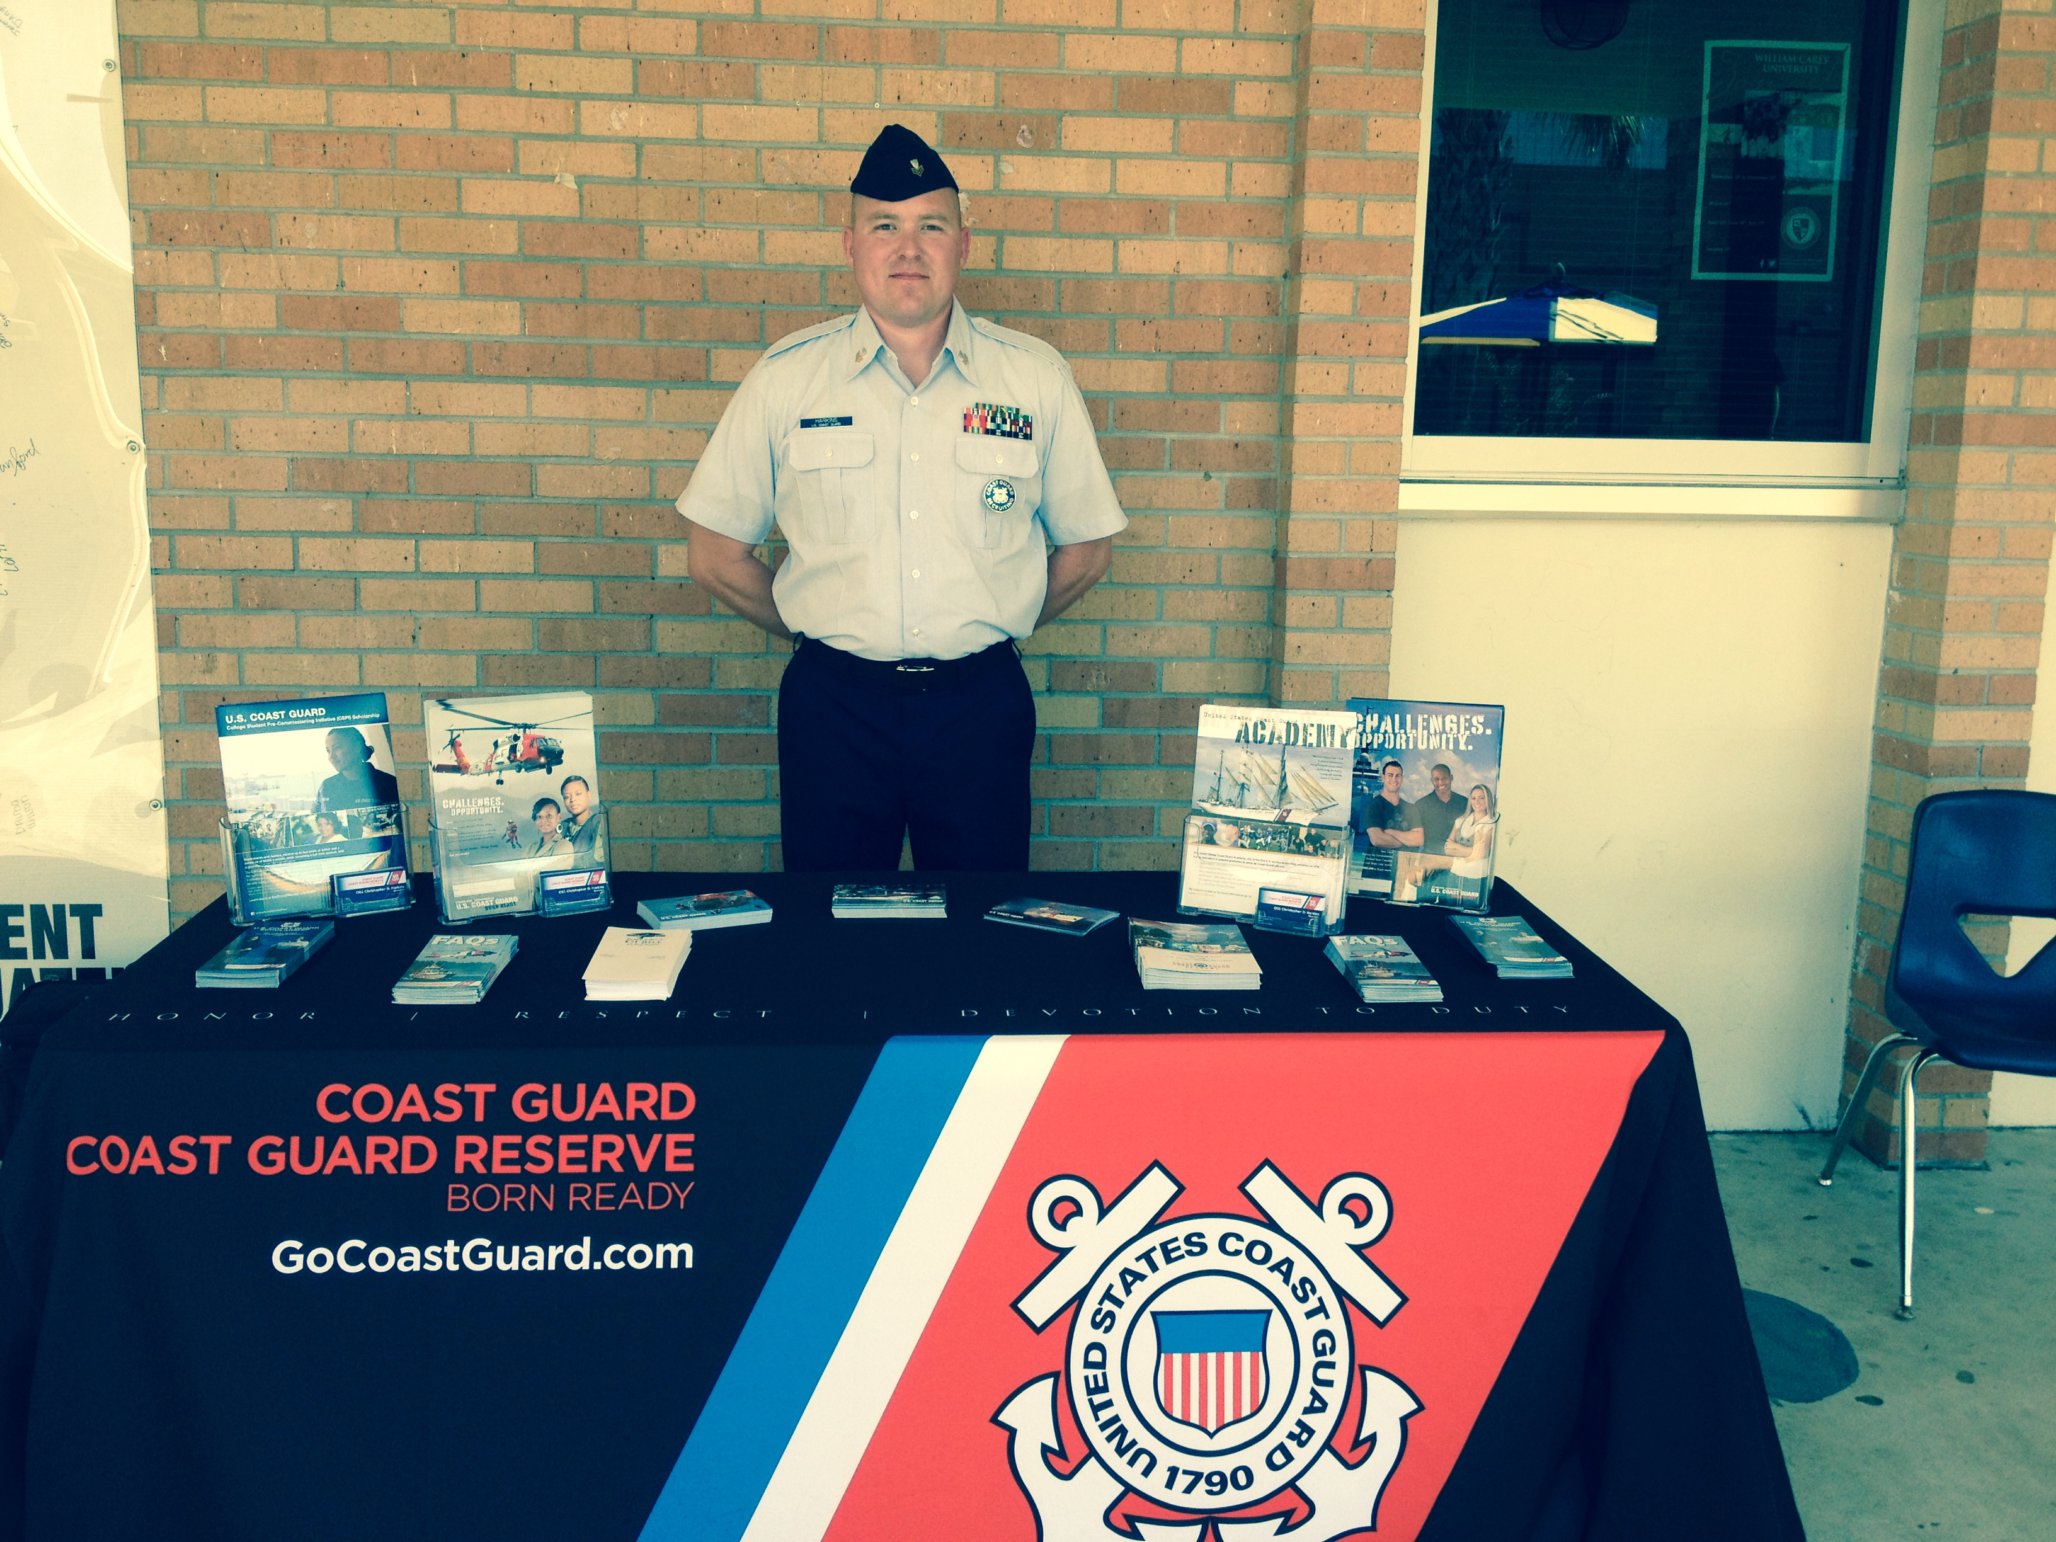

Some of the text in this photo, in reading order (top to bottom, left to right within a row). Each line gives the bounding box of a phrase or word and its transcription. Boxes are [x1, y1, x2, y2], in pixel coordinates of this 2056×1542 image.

[1755, 54, 1796, 64] WILLIAM
[1763, 64, 1820, 74] UNIVERSITY
[985, 480, 999, 496] COAST
[986, 497, 1015, 511] RECRUITING
[225, 707, 327, 724] U.S. COAST GUARD
[1356, 713, 1492, 735] CHALLENGES.
[1235, 720, 1355, 748] ACADEMY
[1354, 732, 1473, 750] OPPORTUNITY.
[471, 899, 495, 908] COAST
[0, 904, 103, 960] ENT
[431, 935, 499, 946] FAQs
[1336, 935, 1398, 946] FAQs
[108, 1012, 316, 1021] HONOR
[514, 1010, 772, 1019] RESPECT
[961, 1005, 1568, 1017] DEVOTION TO DUTY
[316, 1082, 696, 1123] COAST GUARD
[66, 1133, 696, 1176] COAST GUARD RESERVE
[447, 1181, 695, 1212] BORN READY
[271, 1236, 694, 1274] GoCoastGuard.com
[1083, 1231, 1337, 1478] UNITED STATES COAST GUARD
[1164, 1464, 1254, 1496] 1790
